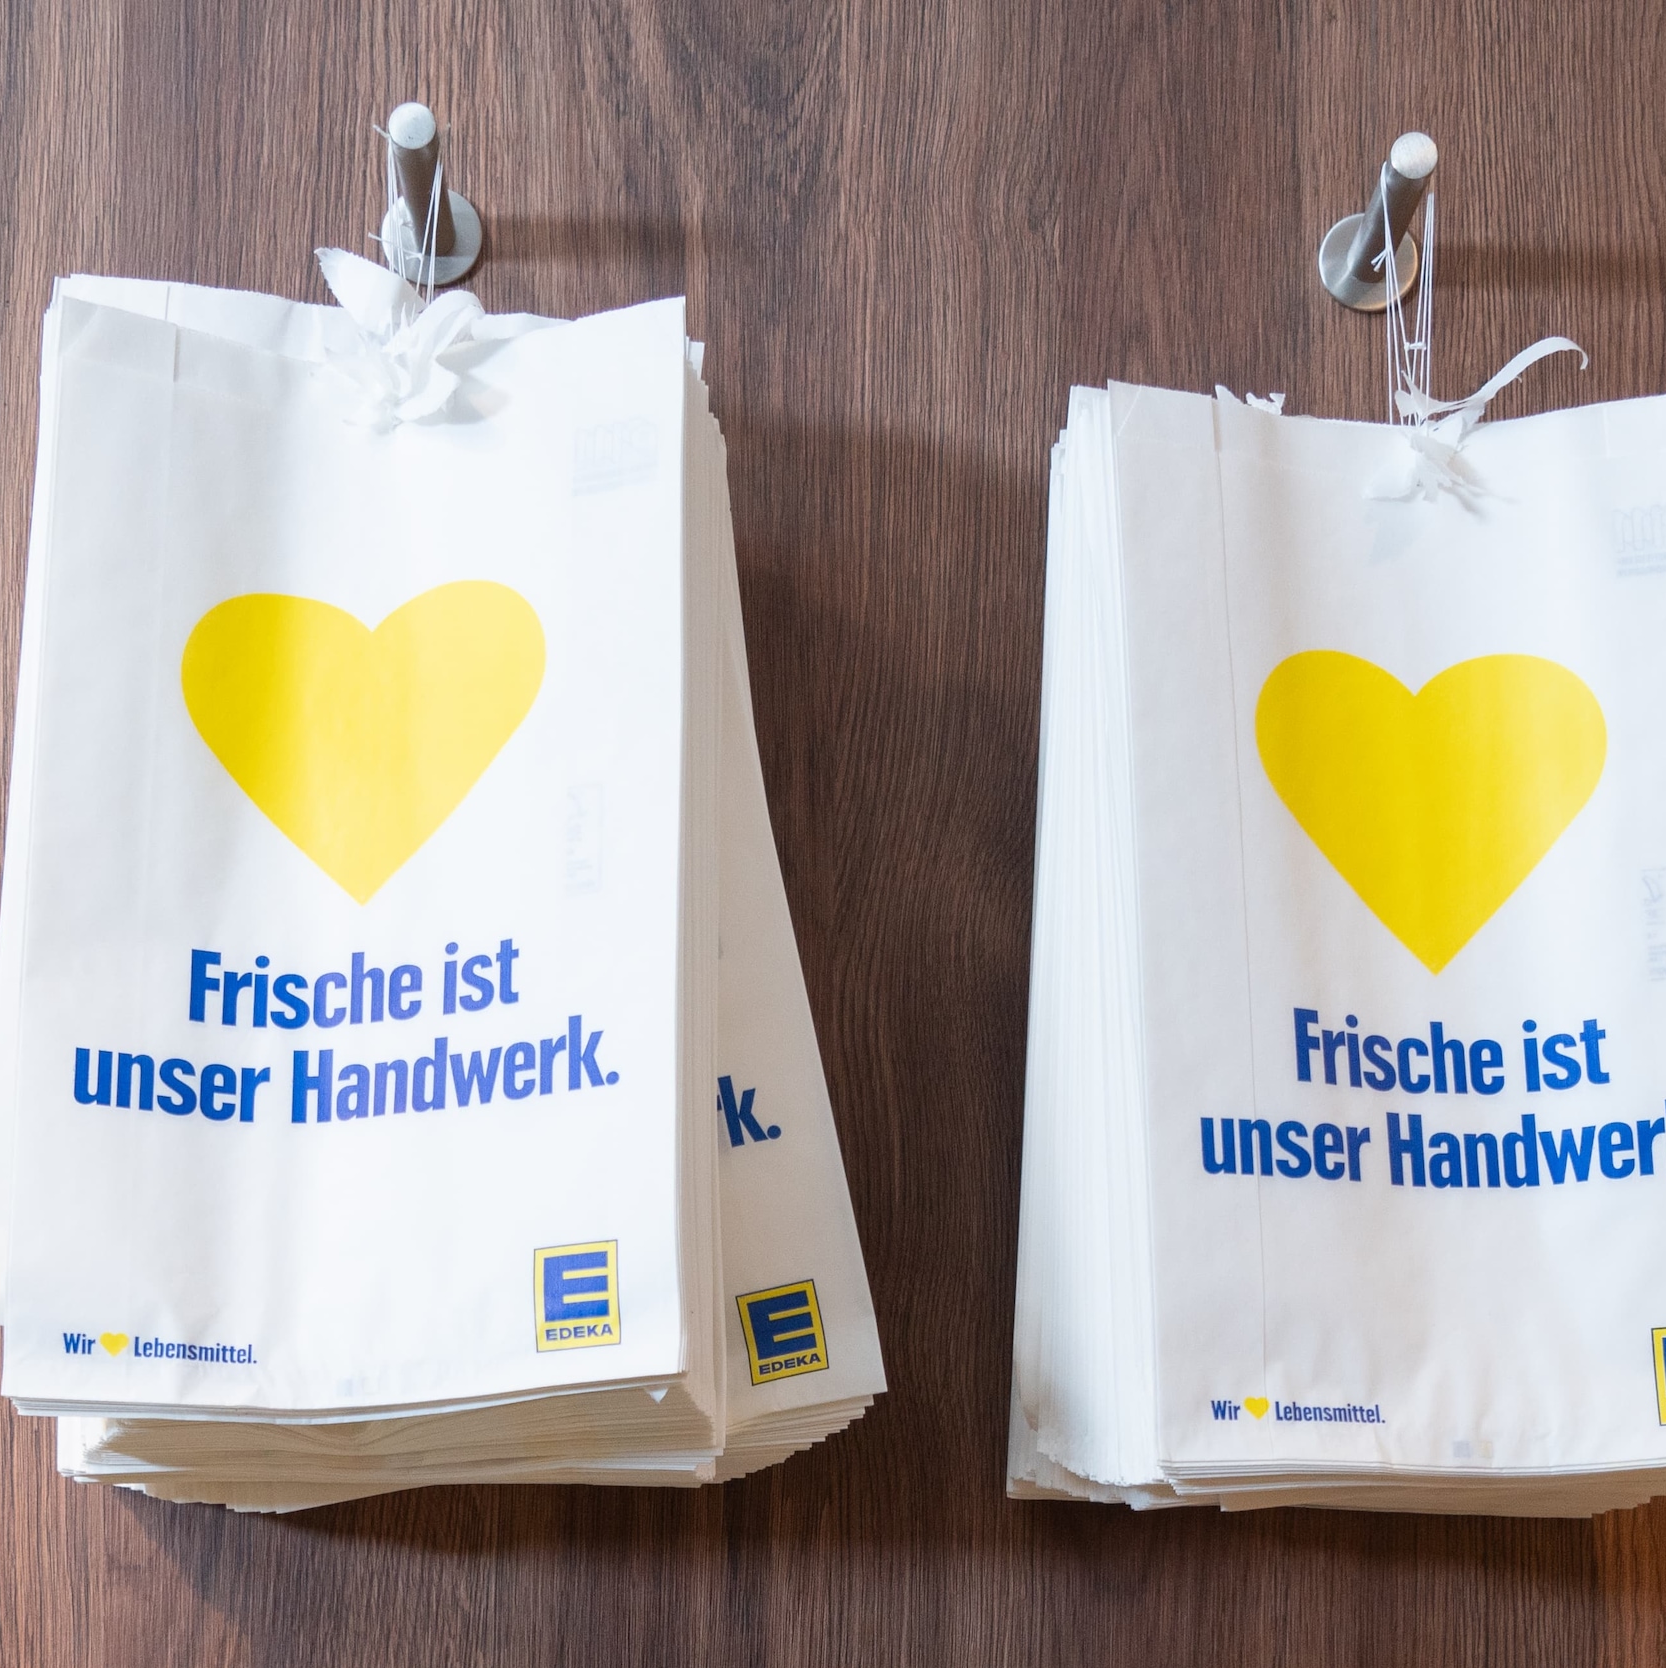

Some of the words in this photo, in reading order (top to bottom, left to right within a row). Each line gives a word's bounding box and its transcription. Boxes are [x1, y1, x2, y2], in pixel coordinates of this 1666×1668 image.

[189, 949, 422, 1030] Frische
[443, 939, 519, 1014] ist
[74, 1047, 270, 1122] unser
[290, 1014, 620, 1124] Handwerk.
[1293, 1007, 1505, 1095] Frische
[1522, 1019, 1610, 1092] ist
[1200, 1117, 1371, 1182] unser
[544, 1251, 609, 1322] E
[63, 1333, 95, 1354] Wir
[134, 1336, 257, 1363] Lebensmittel.
[545, 1324, 615, 1342] EDEKA
[746, 1290, 818, 1359] E
[758, 1353, 822, 1376] EDEKA
[1211, 1400, 1240, 1420] Wir
[1275, 1401, 1385, 1423] Lebensmittel.
